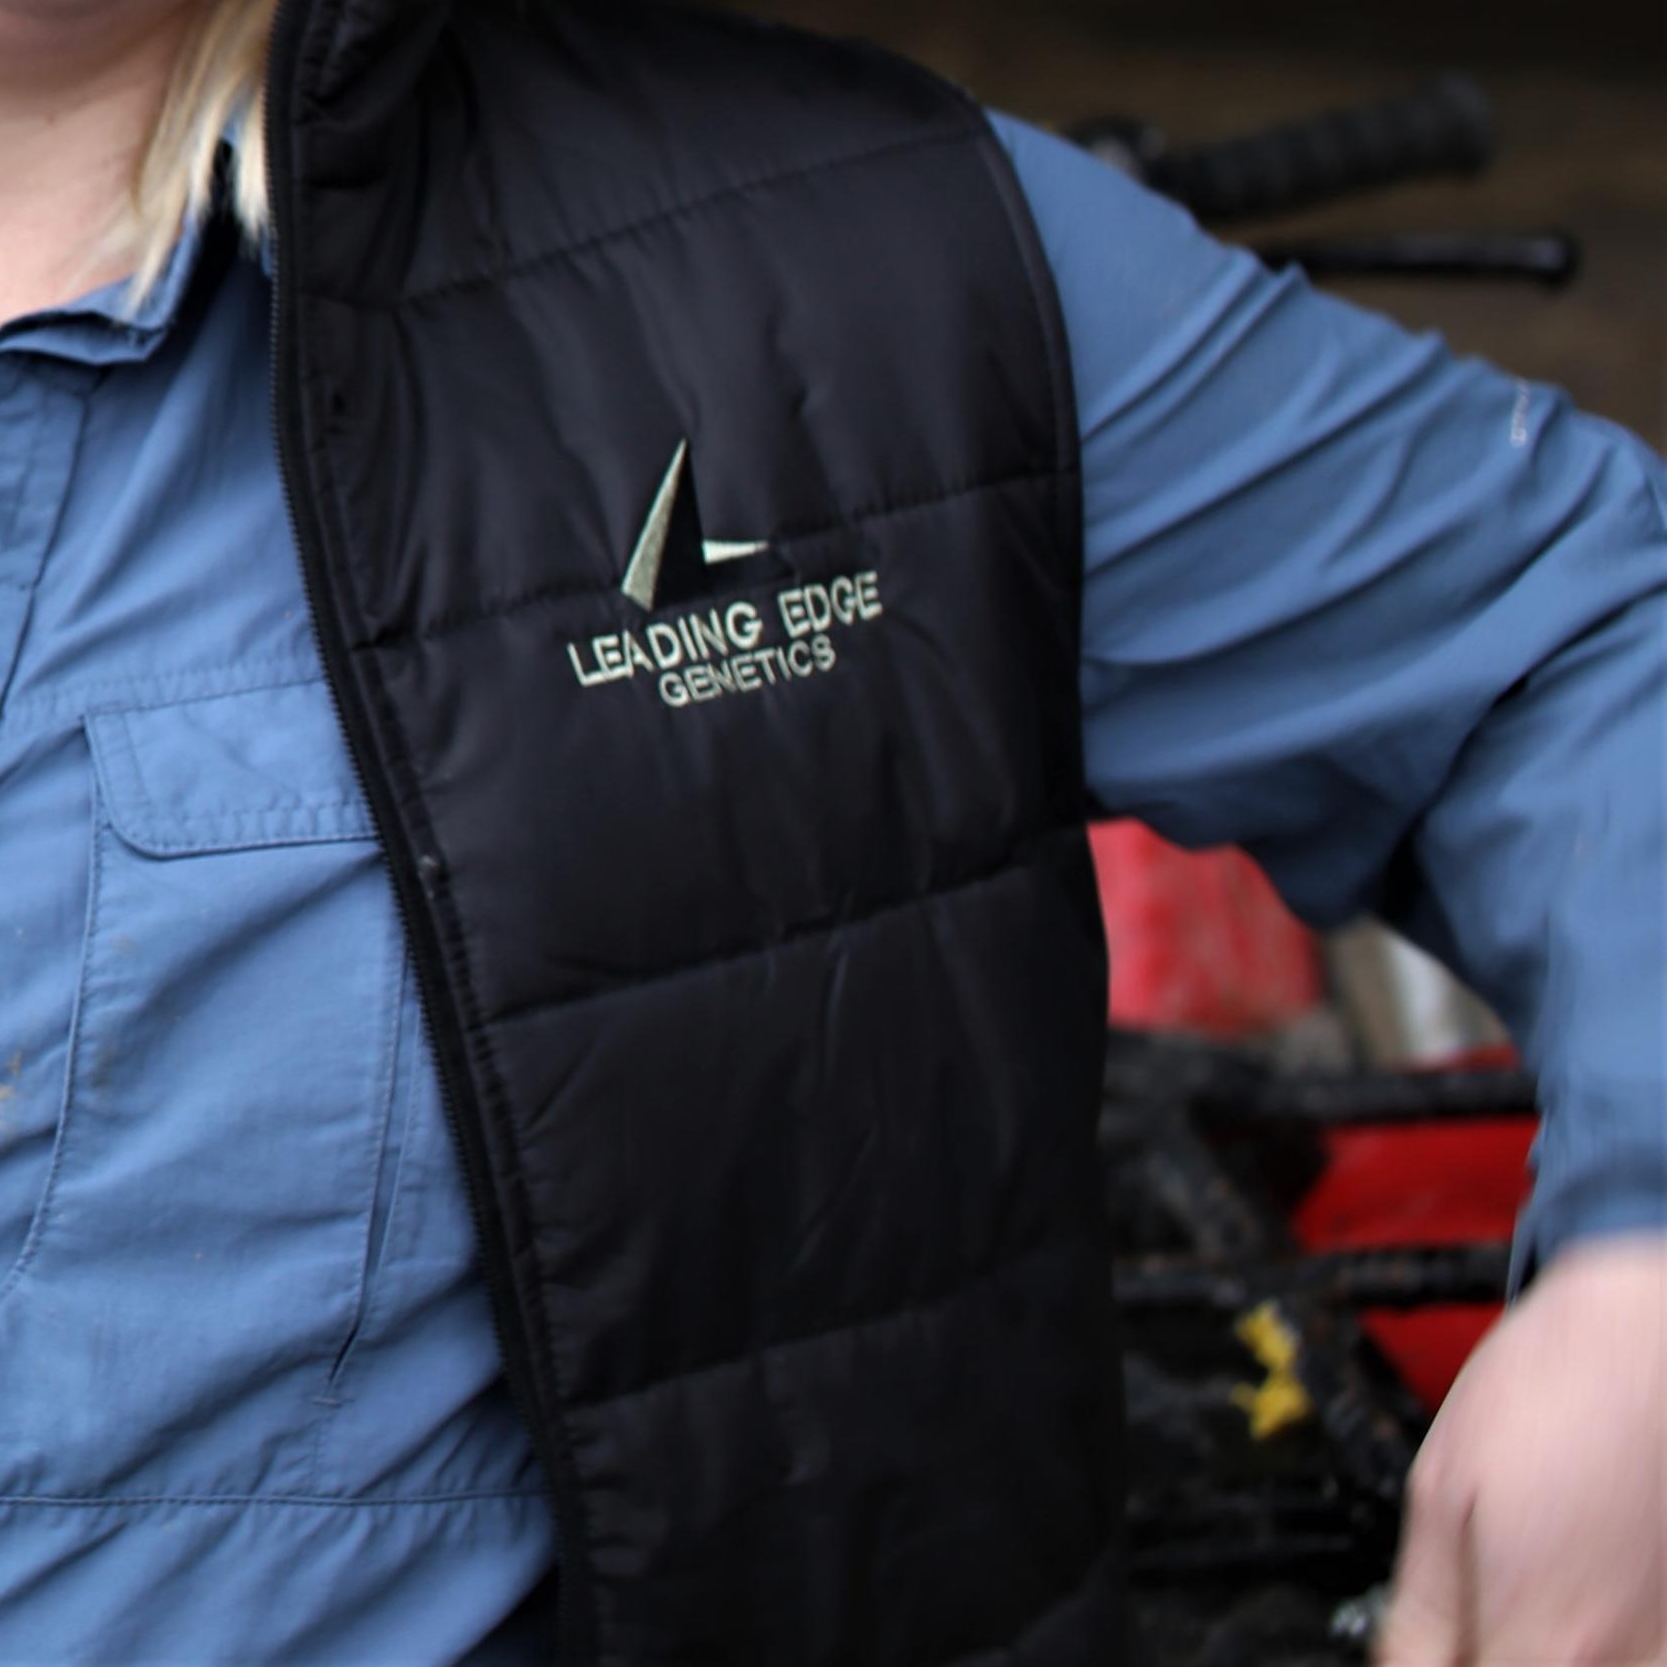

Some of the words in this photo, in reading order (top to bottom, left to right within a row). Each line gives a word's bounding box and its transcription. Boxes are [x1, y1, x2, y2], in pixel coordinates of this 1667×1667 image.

[568, 601, 763, 687] LEADING
[778, 571, 883, 638] EDGE
[658, 634, 837, 707] GENETICS
